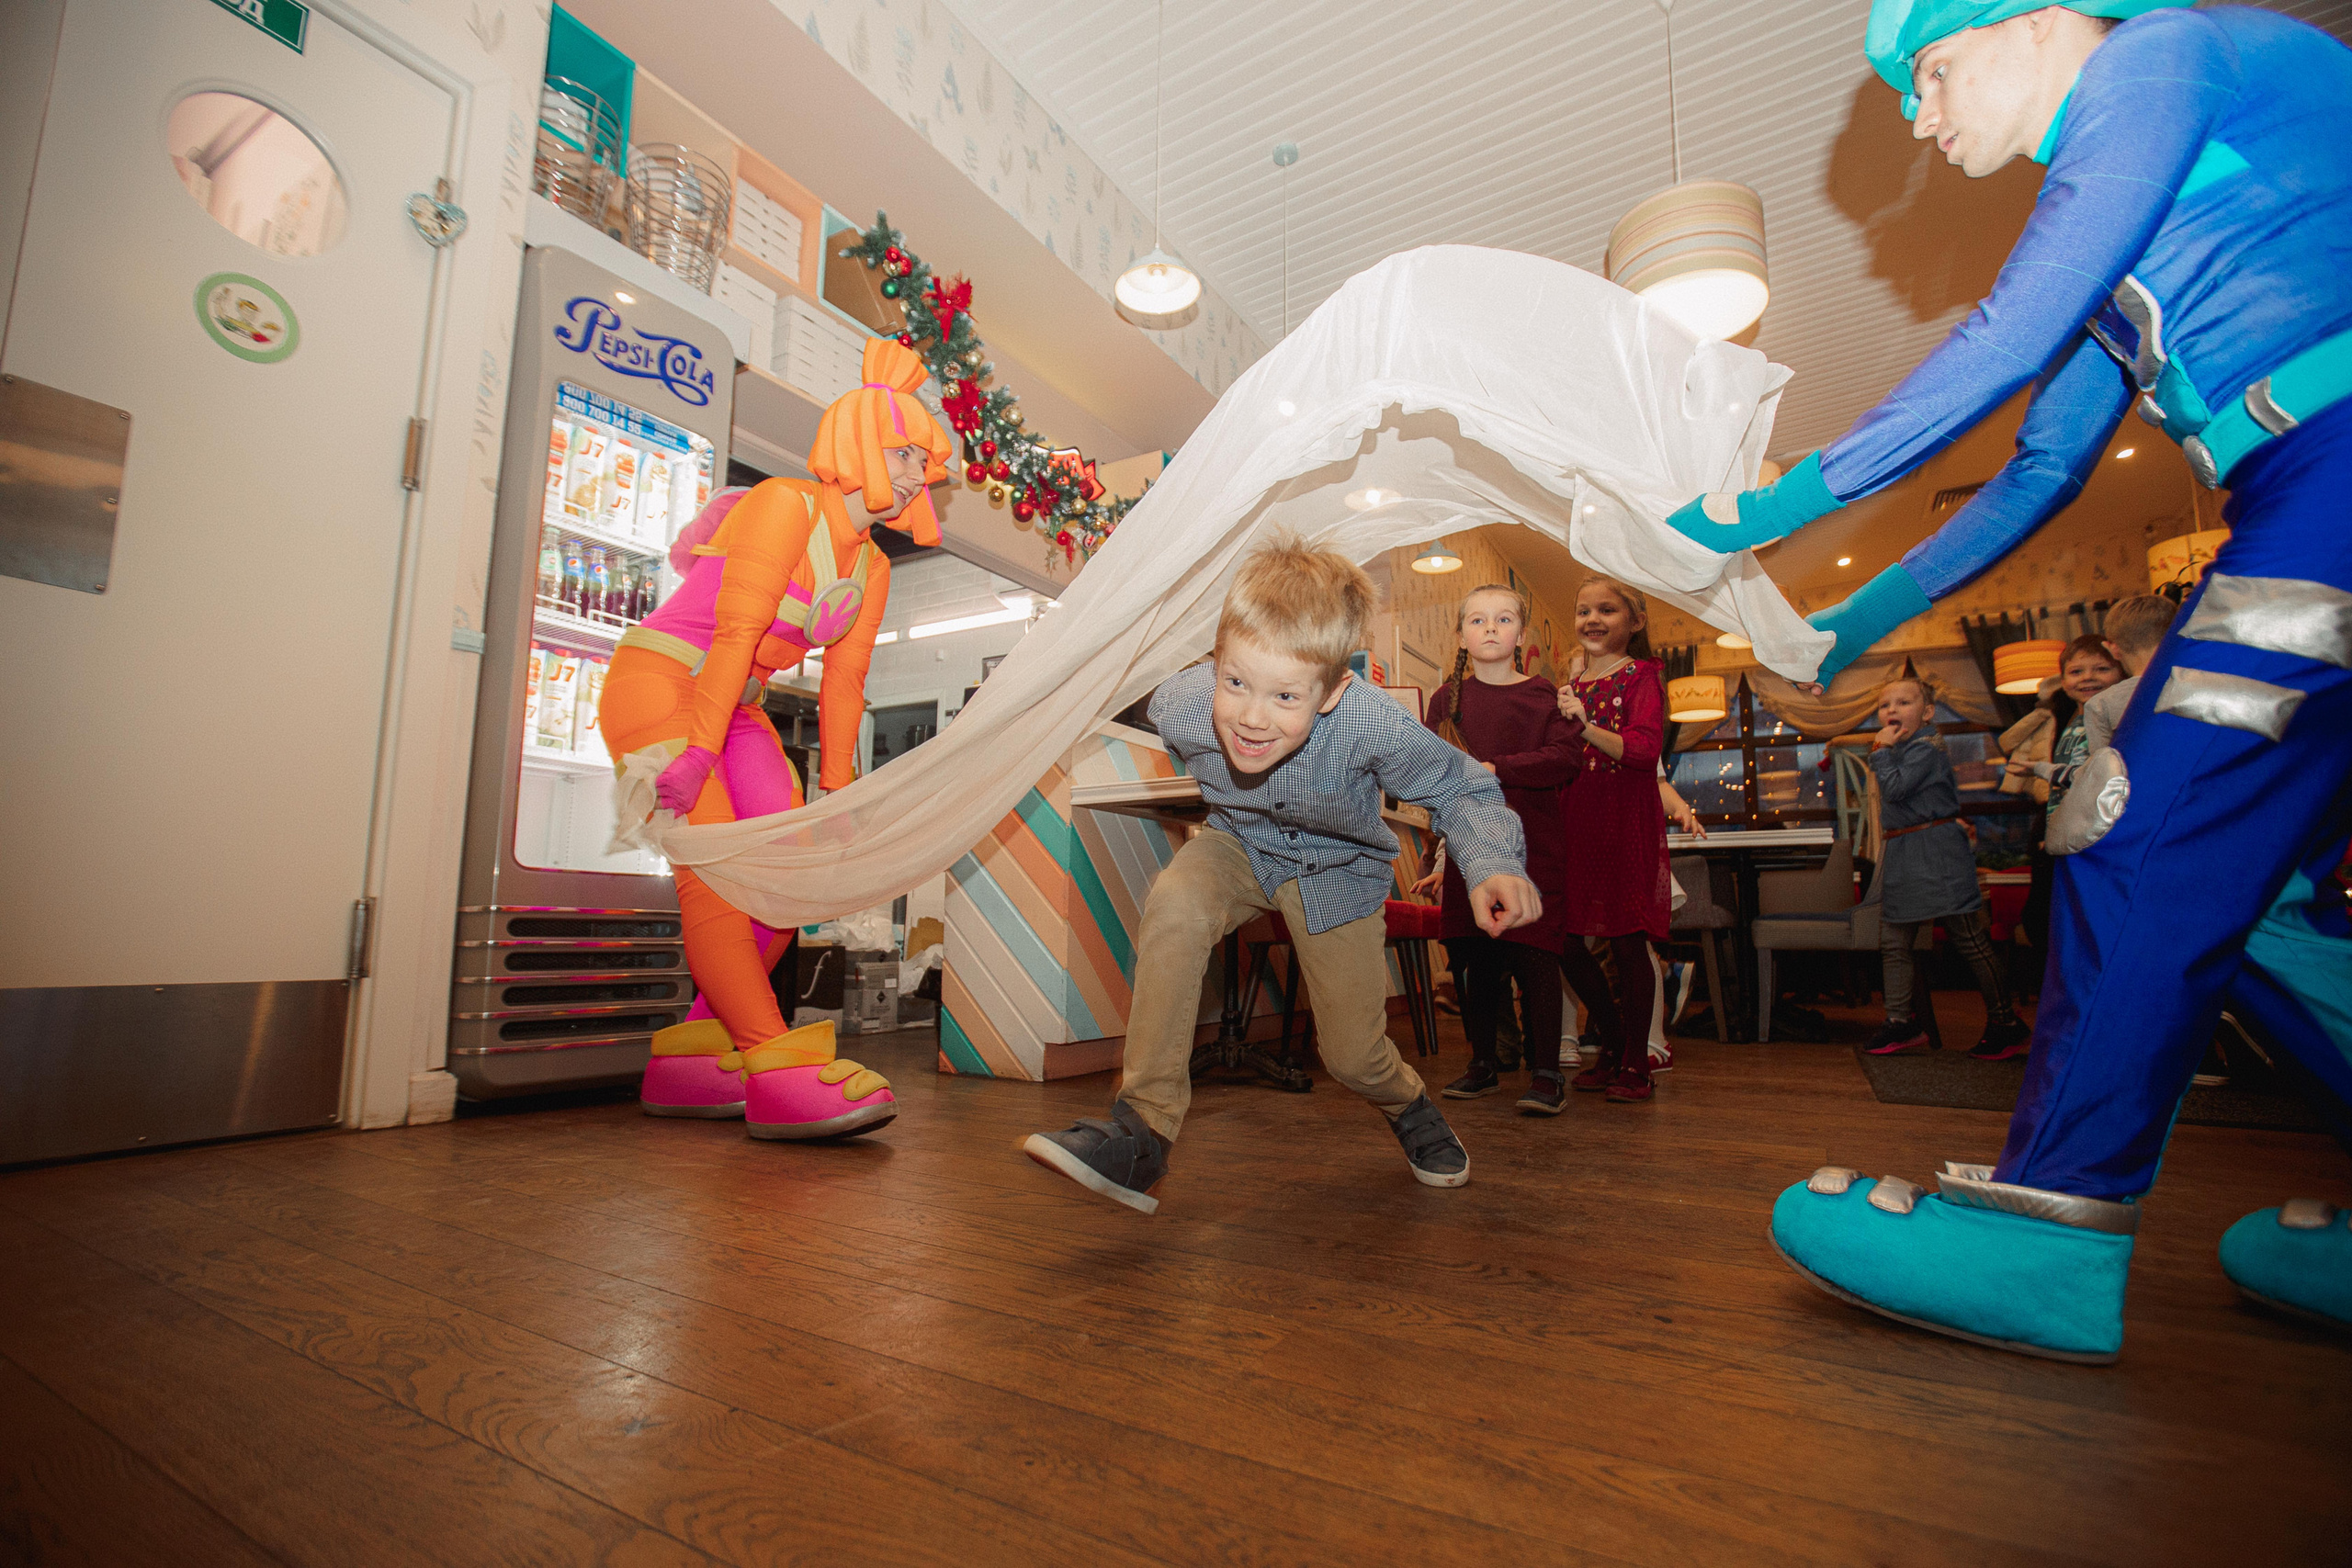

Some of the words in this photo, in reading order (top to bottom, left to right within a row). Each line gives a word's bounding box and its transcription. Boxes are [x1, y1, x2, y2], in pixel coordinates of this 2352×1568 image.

[588, 404, 610, 423] 700
[612, 413, 627, 430] 14
[628, 420, 642, 435] 55
[579, 439, 605, 458] J7
[610, 495, 631, 510] J7
[548, 663, 576, 682] J7
